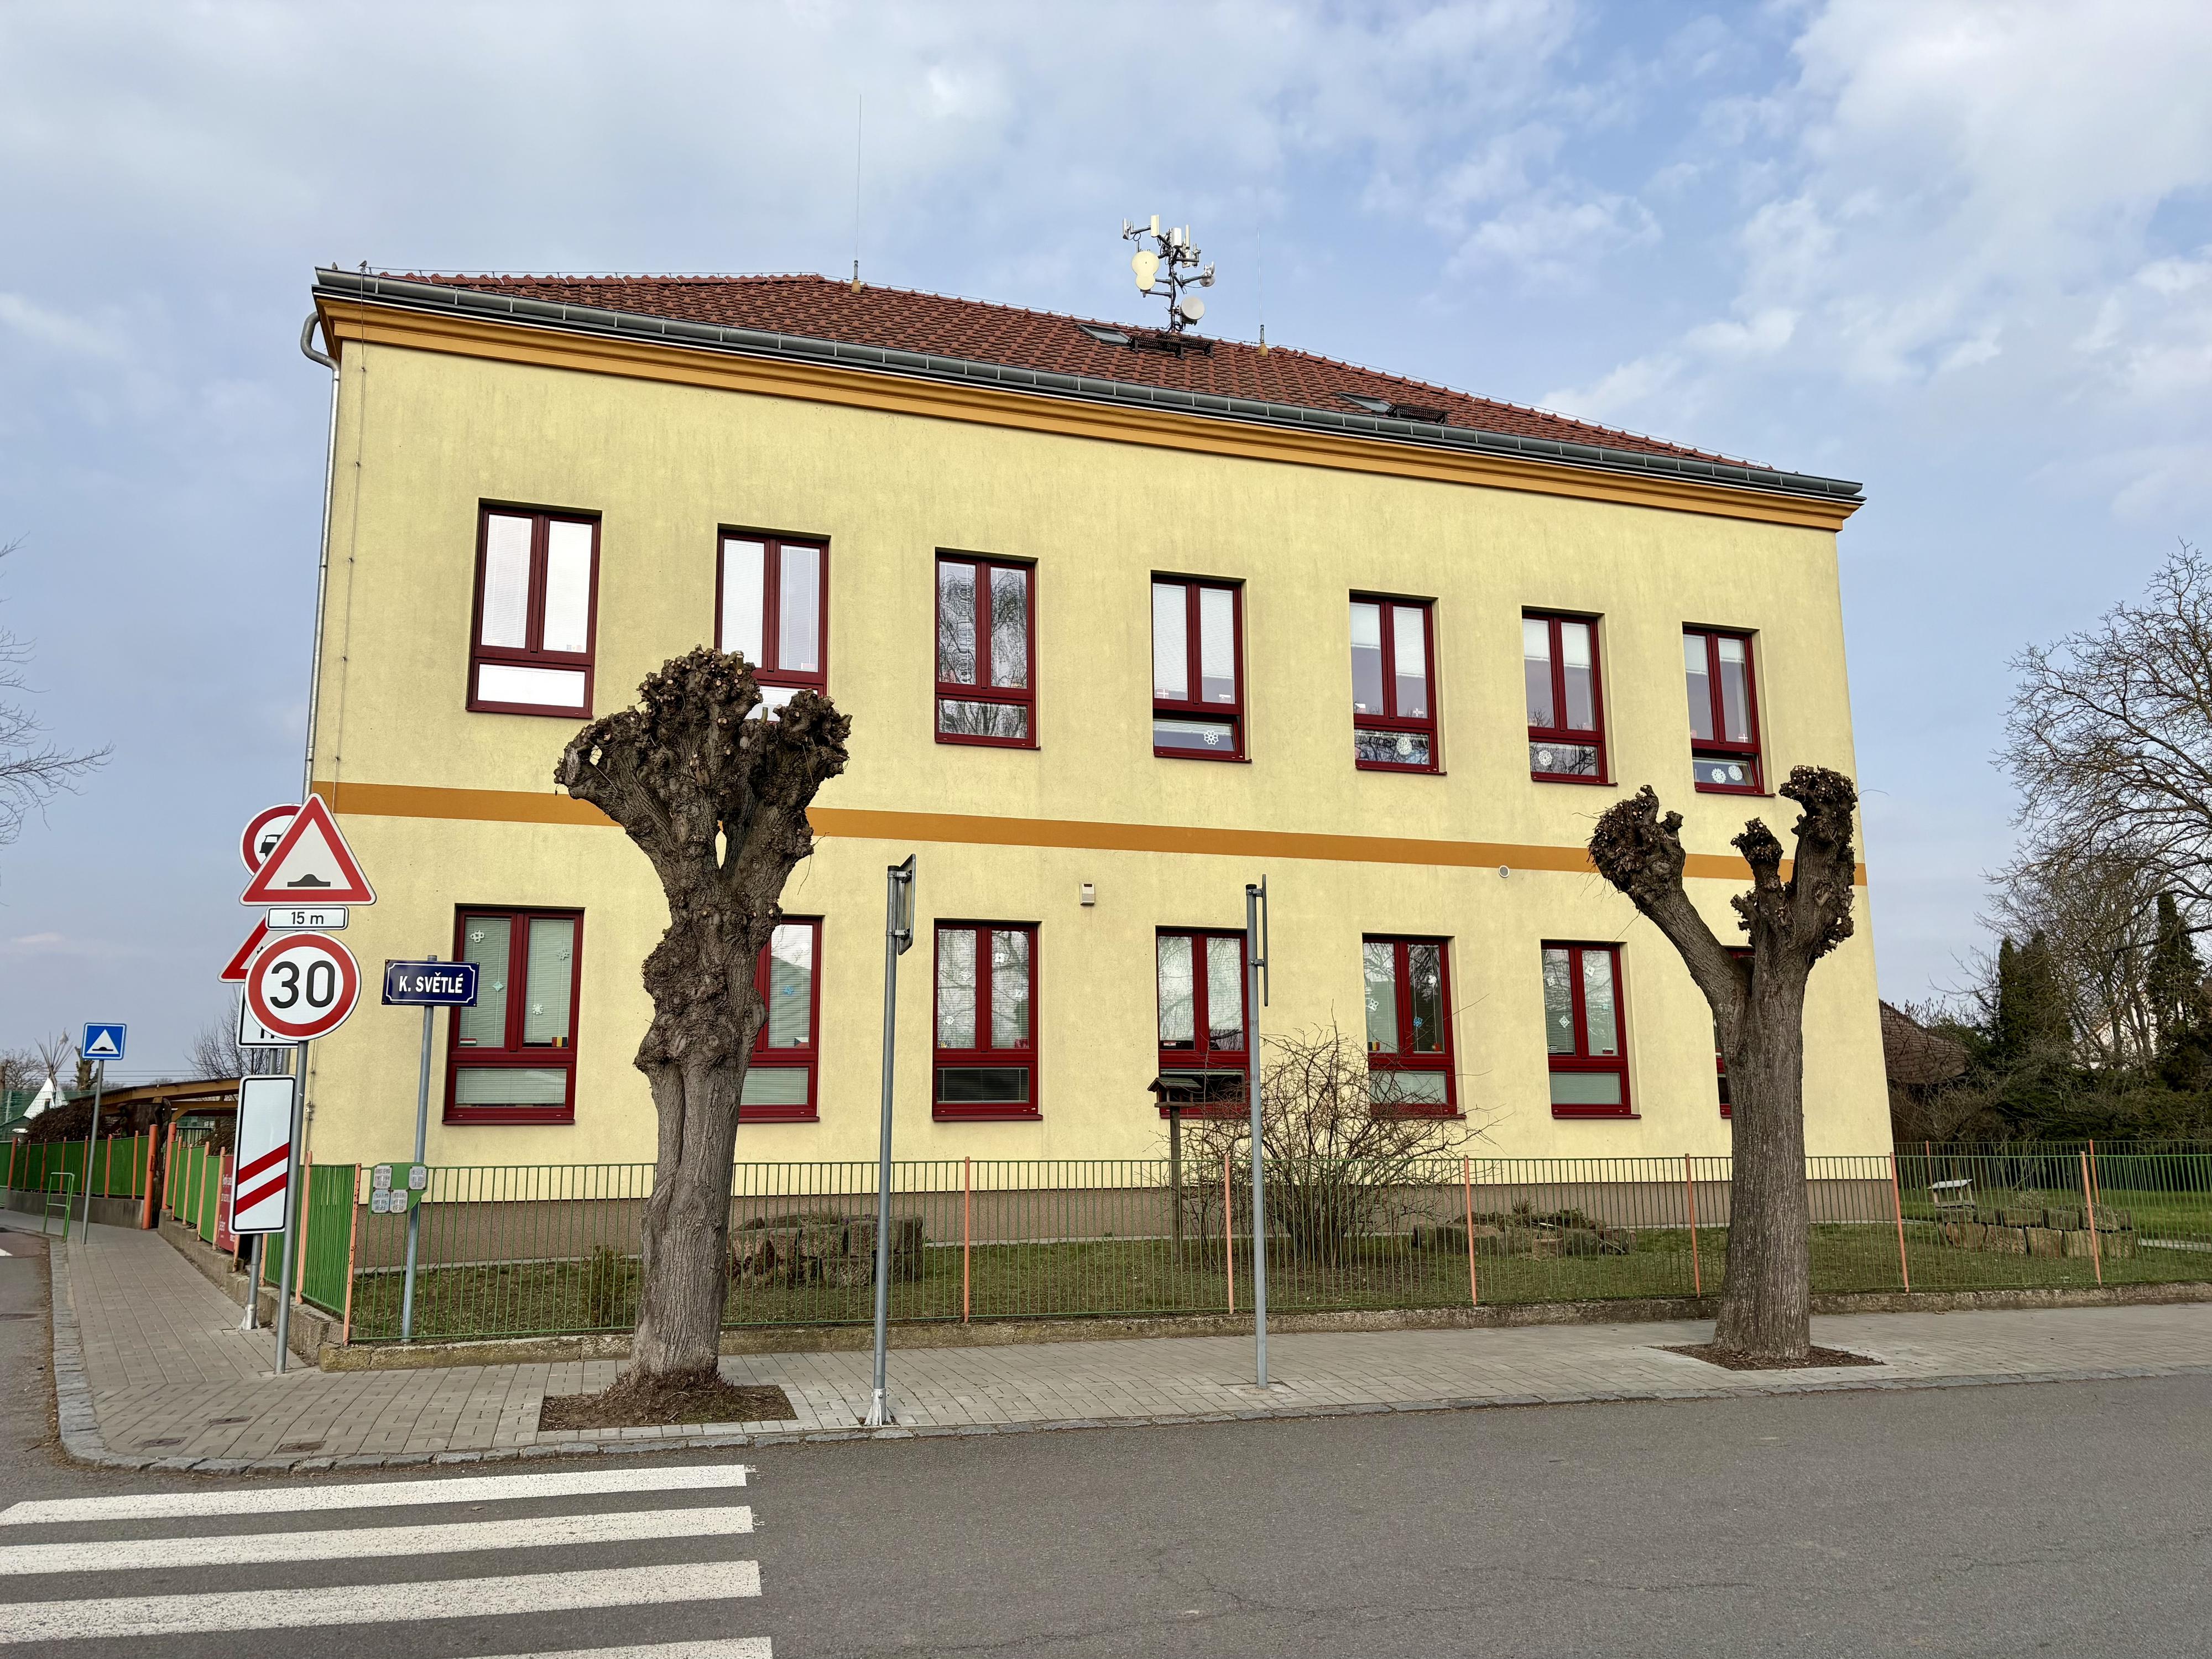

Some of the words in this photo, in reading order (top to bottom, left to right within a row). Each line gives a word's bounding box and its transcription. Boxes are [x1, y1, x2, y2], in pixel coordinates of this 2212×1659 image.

[291, 911, 305, 925] 15
[310, 915, 324, 925] m
[269, 960, 335, 1009] 30
[398, 975, 411, 992] K.
[415, 972, 463, 994] SVĚTLÉ
